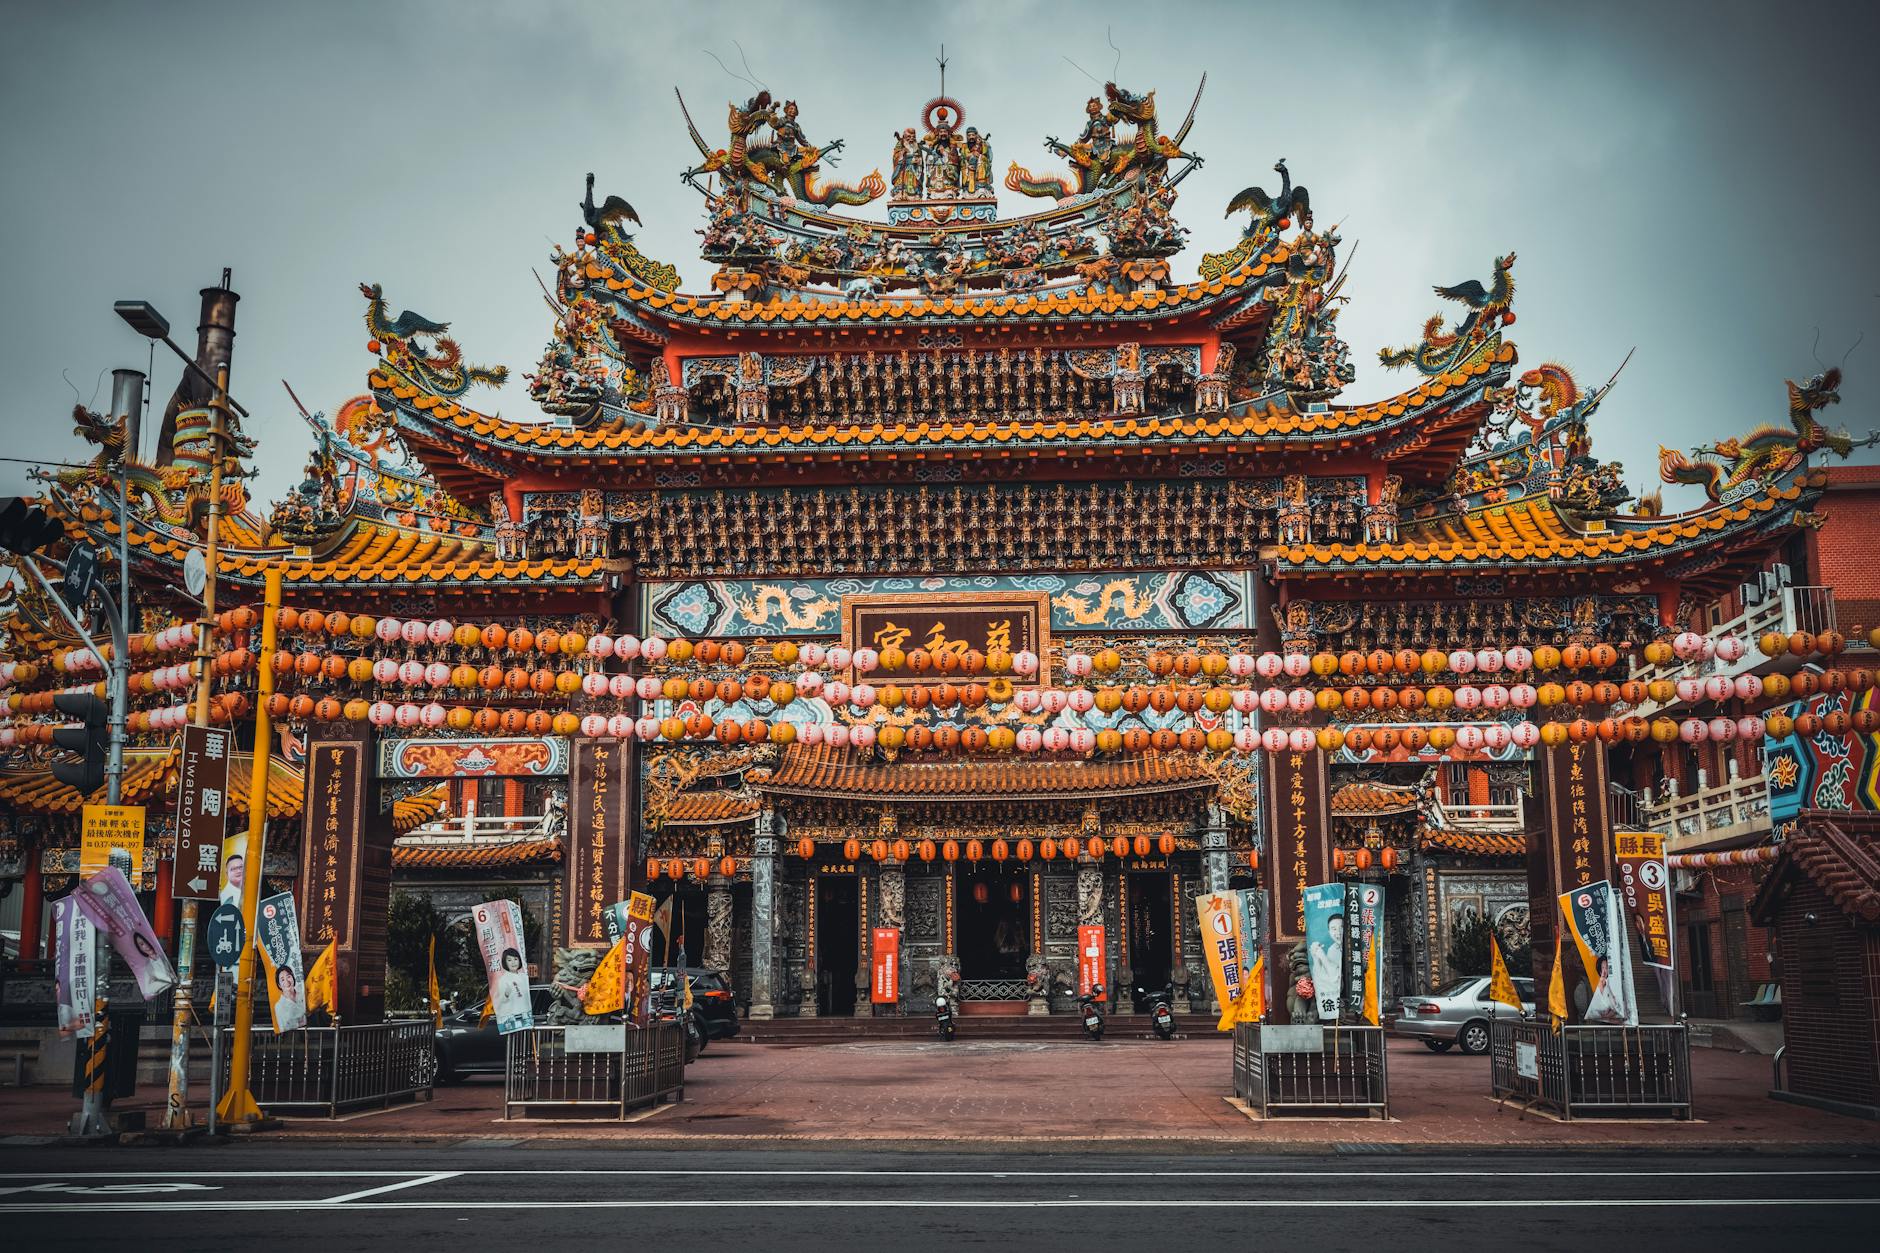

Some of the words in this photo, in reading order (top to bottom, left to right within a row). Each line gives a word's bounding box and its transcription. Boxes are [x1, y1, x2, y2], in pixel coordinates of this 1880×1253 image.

[182, 751, 198, 849] Hwataoyao
[198, 733, 224, 872] 華陶窯
[87, 829, 140, 838] 最後席次機會
[1289, 754, 1308, 932] 祥愛物十方善信平安樂
[1619, 837, 1663, 855] 縣長
[1647, 865, 1658, 885] 3
[1367, 890, 1375, 903] 2
[478, 910, 486, 922] 6
[1217, 914, 1228, 933] 1
